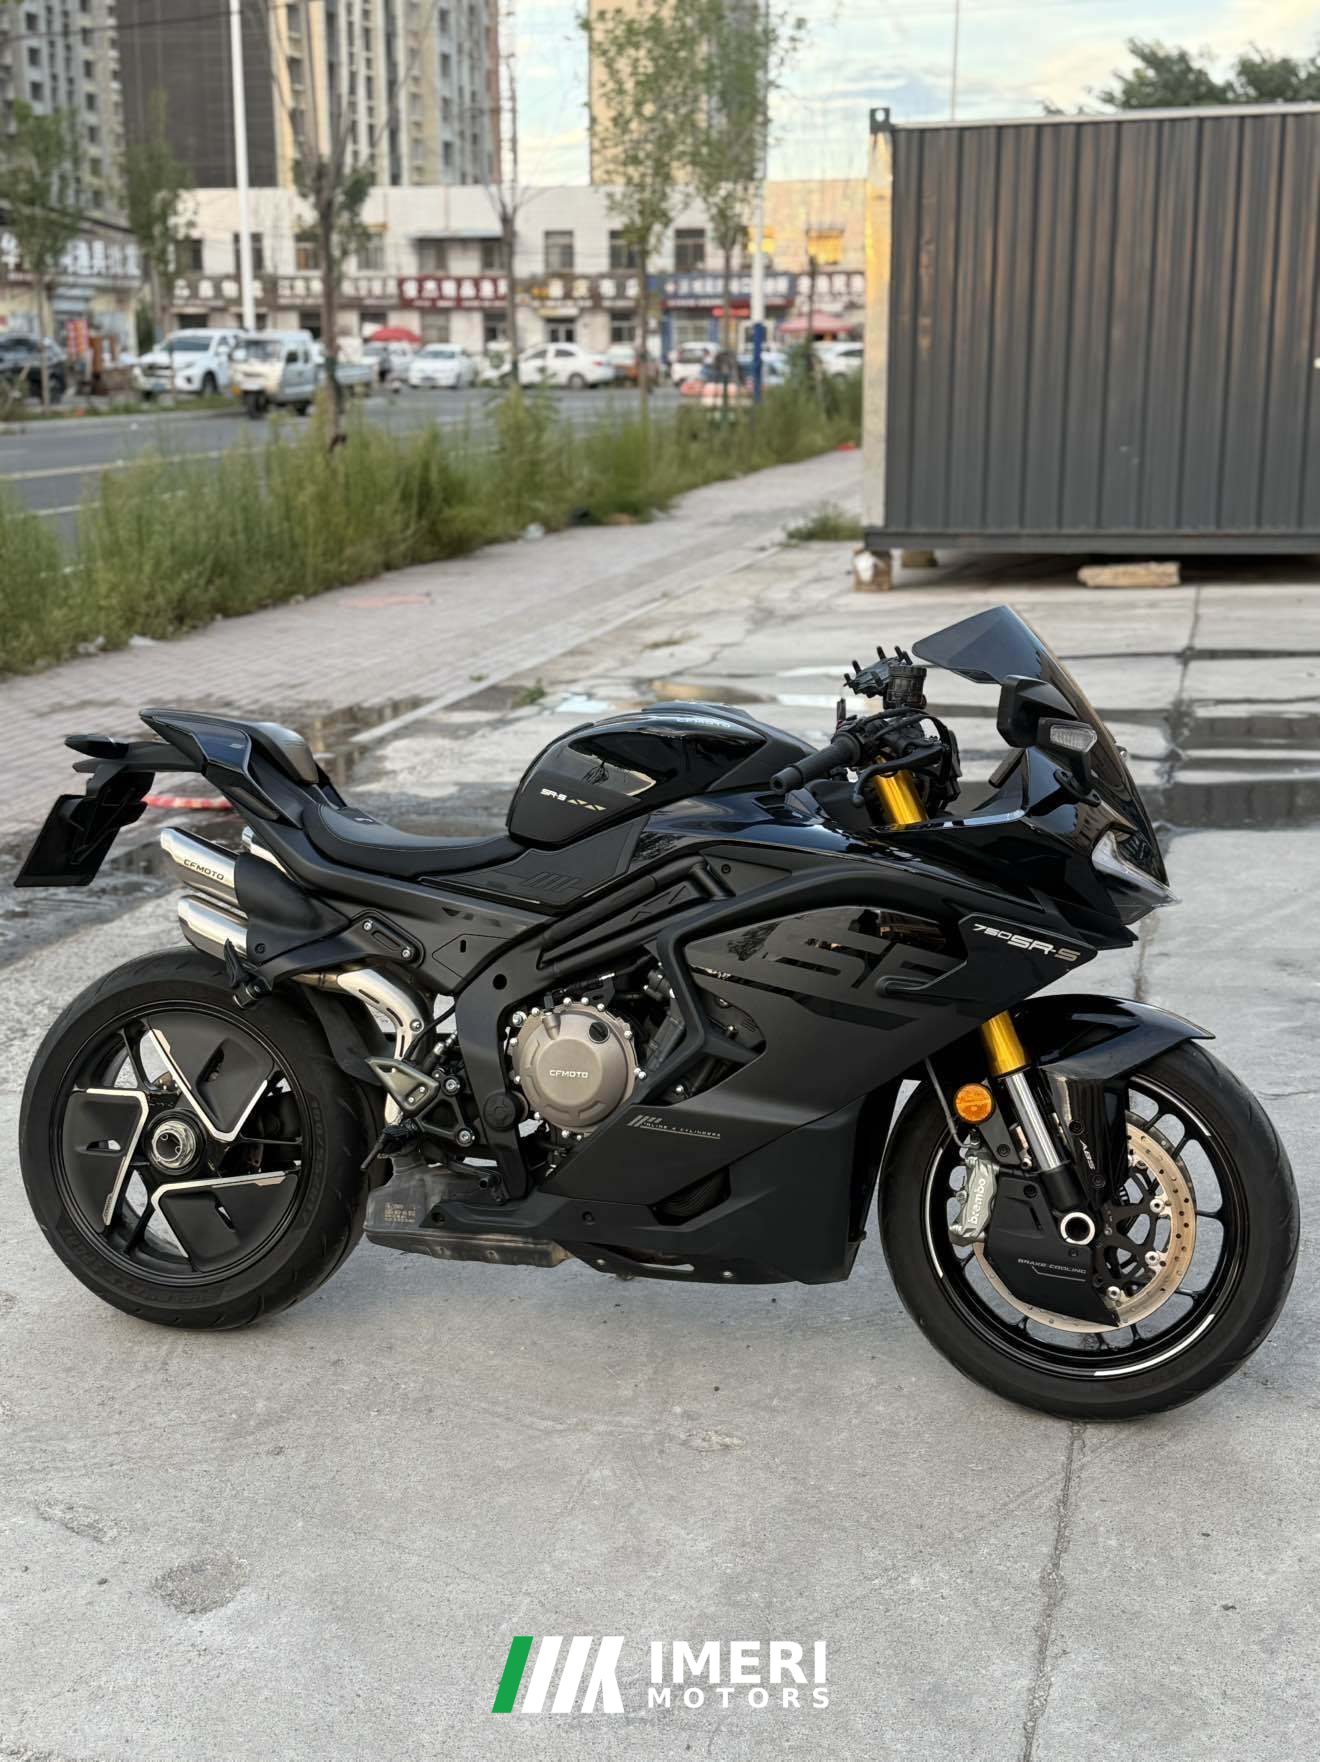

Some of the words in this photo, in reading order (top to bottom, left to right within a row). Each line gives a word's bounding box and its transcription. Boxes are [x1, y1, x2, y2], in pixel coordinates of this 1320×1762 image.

[183, 858, 225, 881] CFMOTO
[971, 923, 1081, 962] 750SR-S
[549, 1069, 589, 1079] CFMOTO
[1079, 1139, 1096, 1170] ABS
[967, 1178, 986, 1225] brembo
